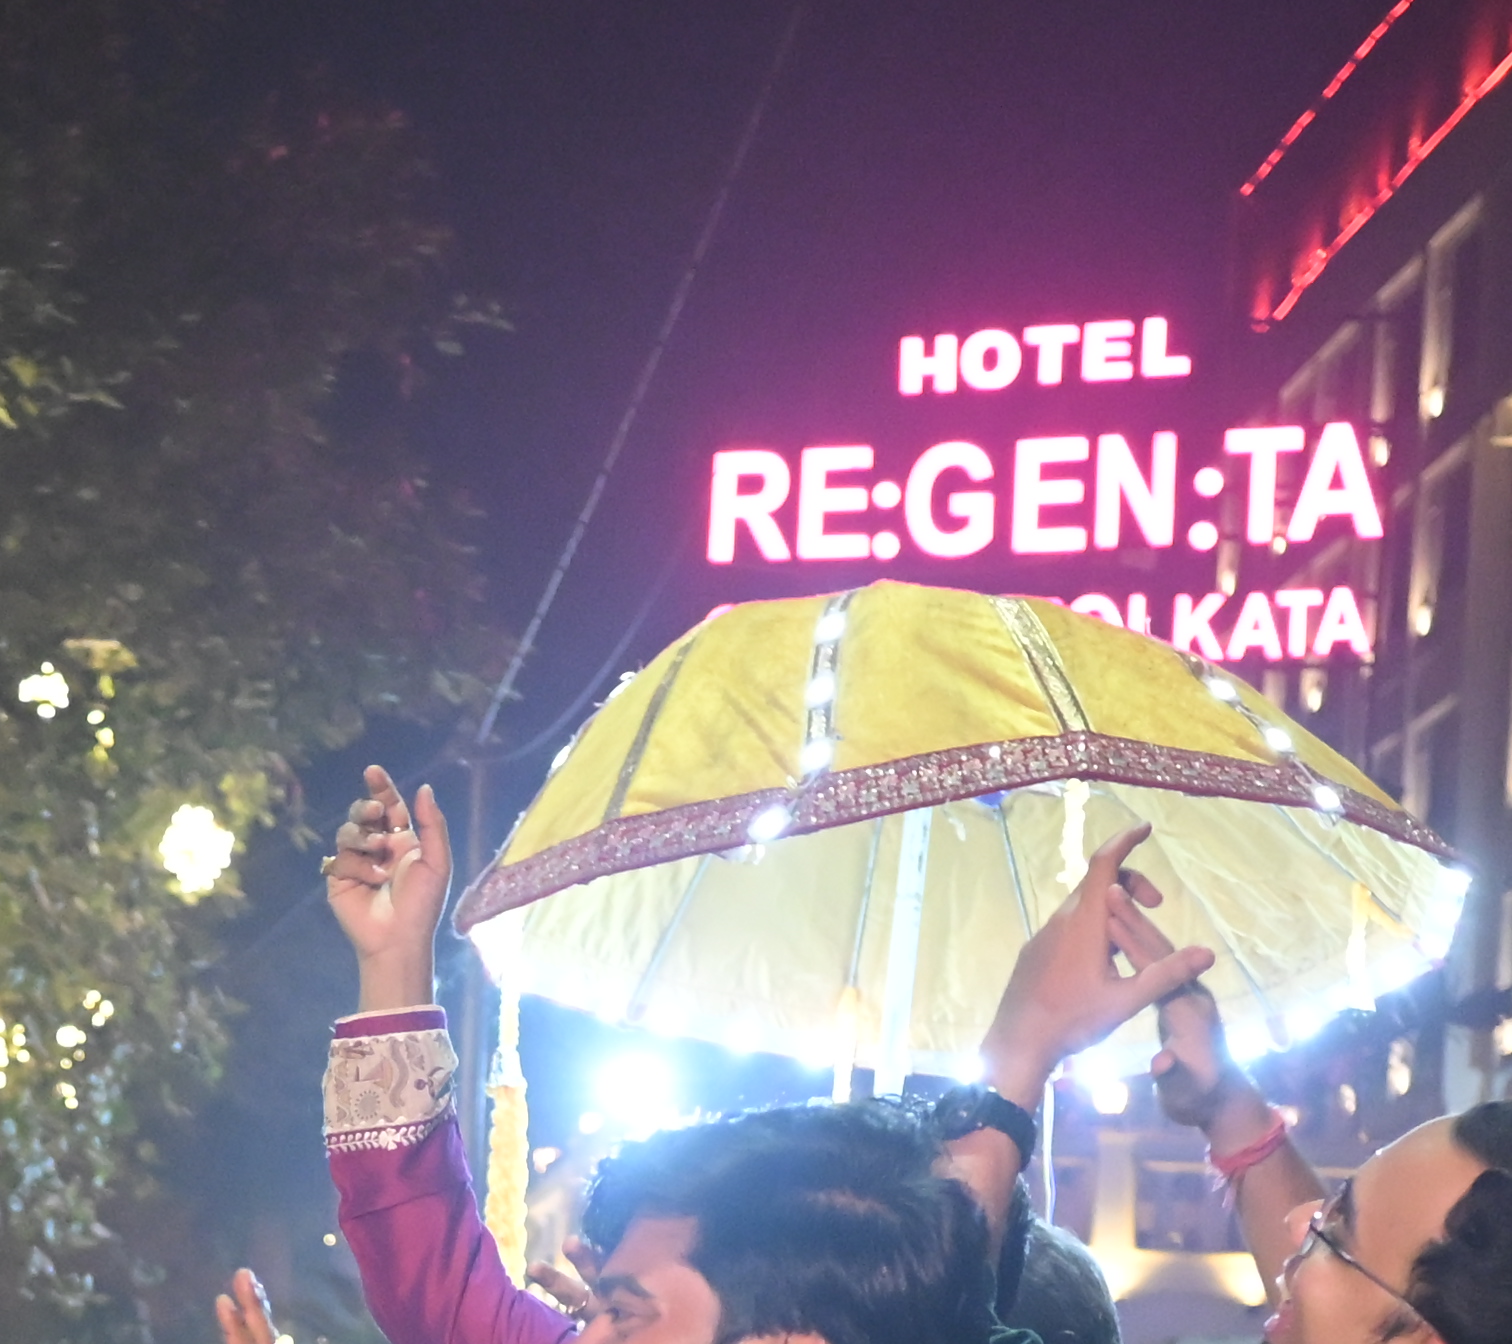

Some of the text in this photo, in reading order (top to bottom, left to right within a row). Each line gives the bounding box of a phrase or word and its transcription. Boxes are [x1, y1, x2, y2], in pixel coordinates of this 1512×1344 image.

[897, 316, 1192, 398] HOTEL
[705, 420, 1385, 567] RE:GEN:TA
[1051, 585, 1372, 663] KATA
